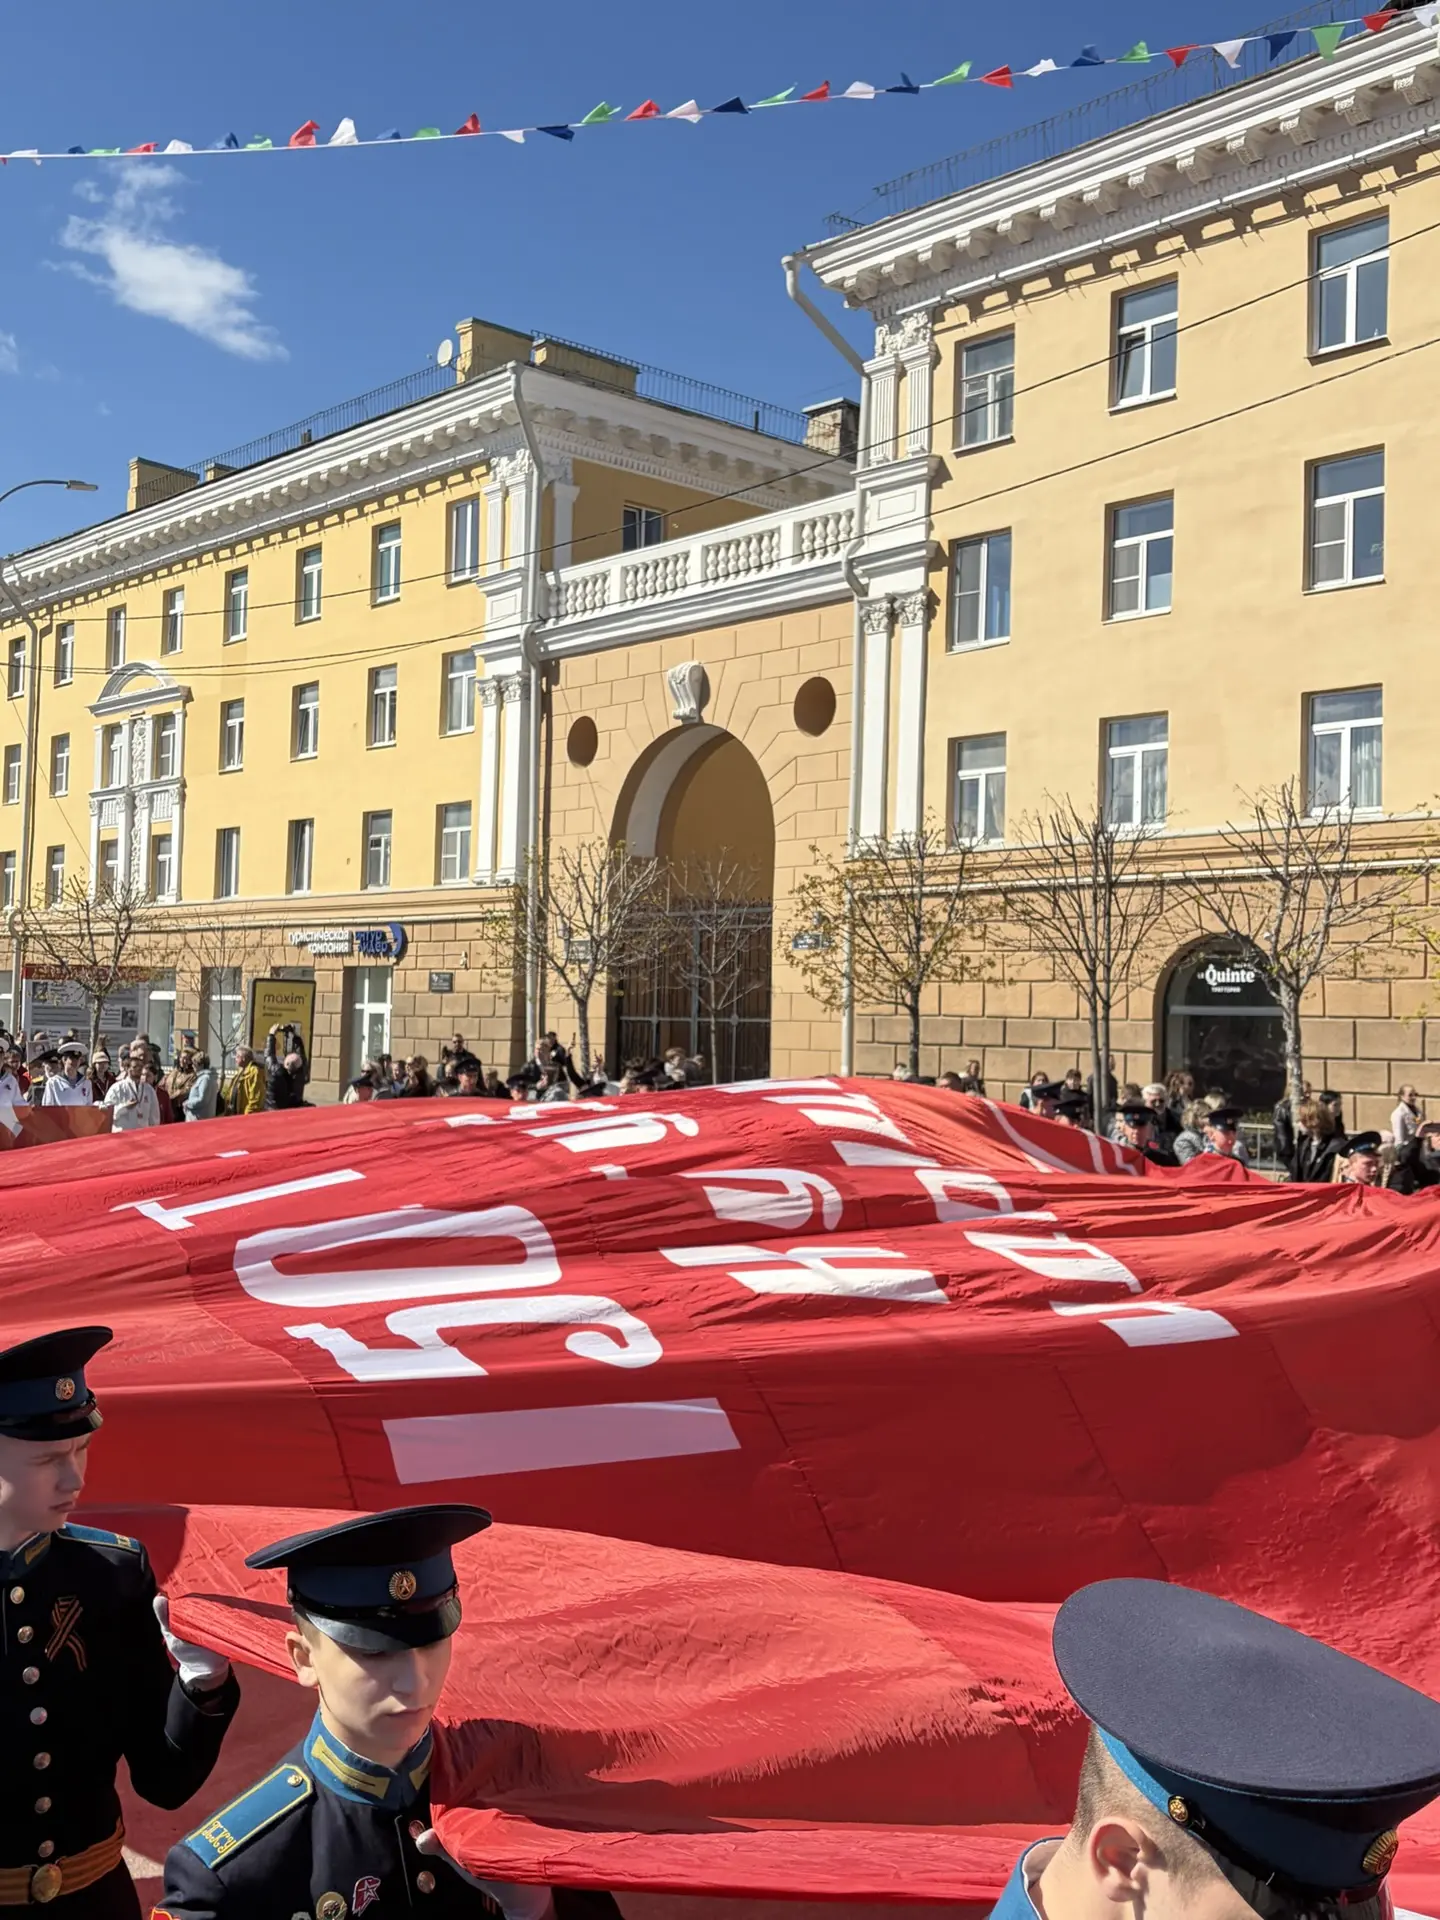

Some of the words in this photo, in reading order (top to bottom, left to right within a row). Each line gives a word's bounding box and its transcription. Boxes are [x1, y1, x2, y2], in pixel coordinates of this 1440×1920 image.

[288, 929, 350, 945] туристическая
[307, 941, 350, 954] компания
[1205, 964, 1256, 986] Quinte
[263, 993, 305, 1005] maxim
[233, 1204, 741, 1485] 150
